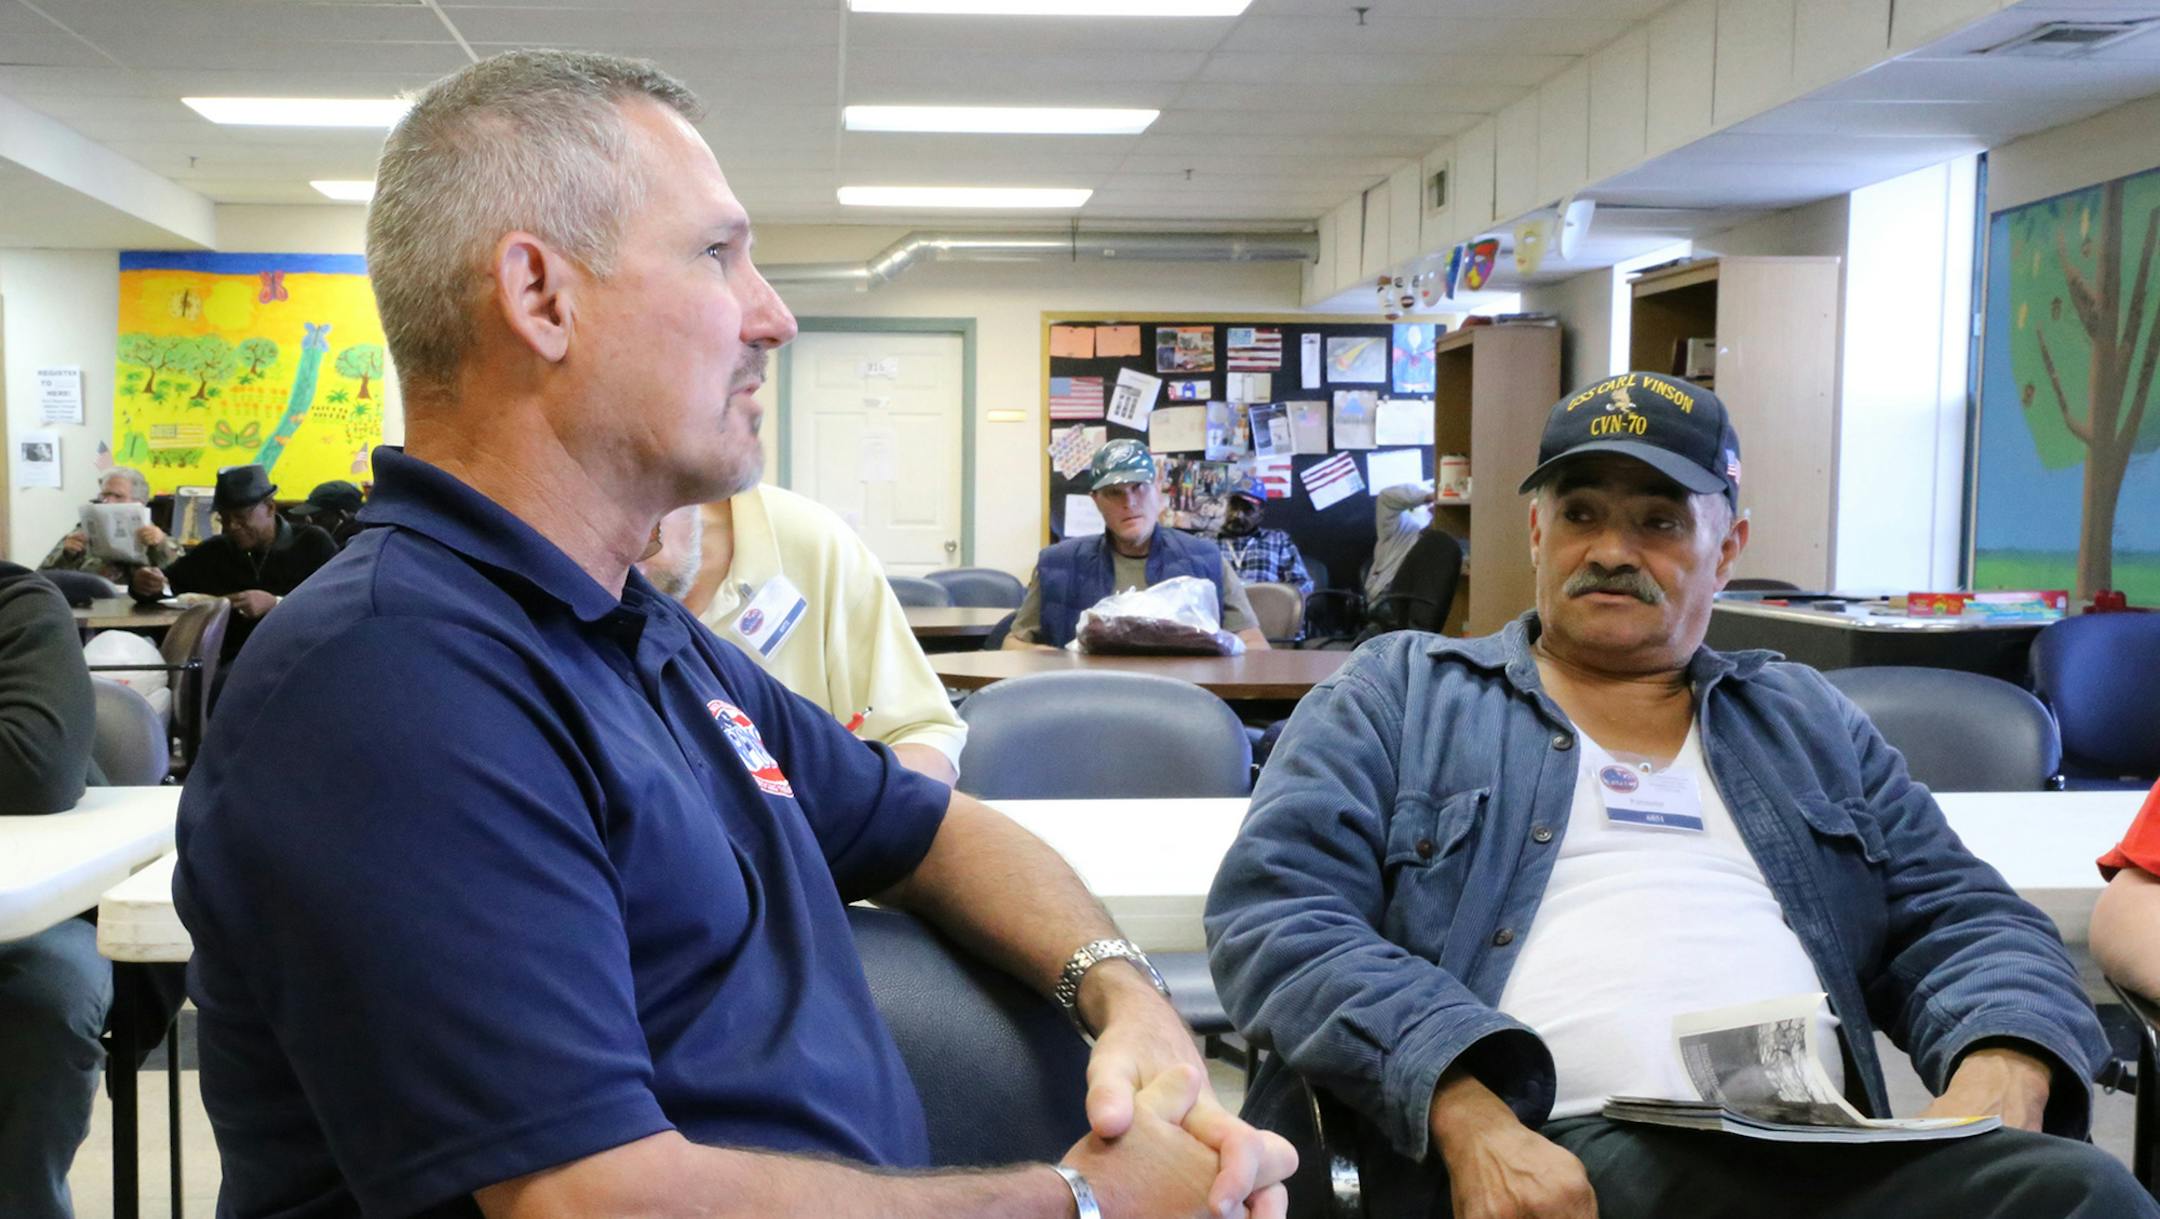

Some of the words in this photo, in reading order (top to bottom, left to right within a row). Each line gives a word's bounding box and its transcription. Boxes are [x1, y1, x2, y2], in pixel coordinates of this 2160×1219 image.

[1567, 387, 1597, 412] USS
[1597, 373, 1637, 394] CARL
[1643, 376, 1694, 414] VINSON
[1590, 412, 1648, 436] CVN-70
